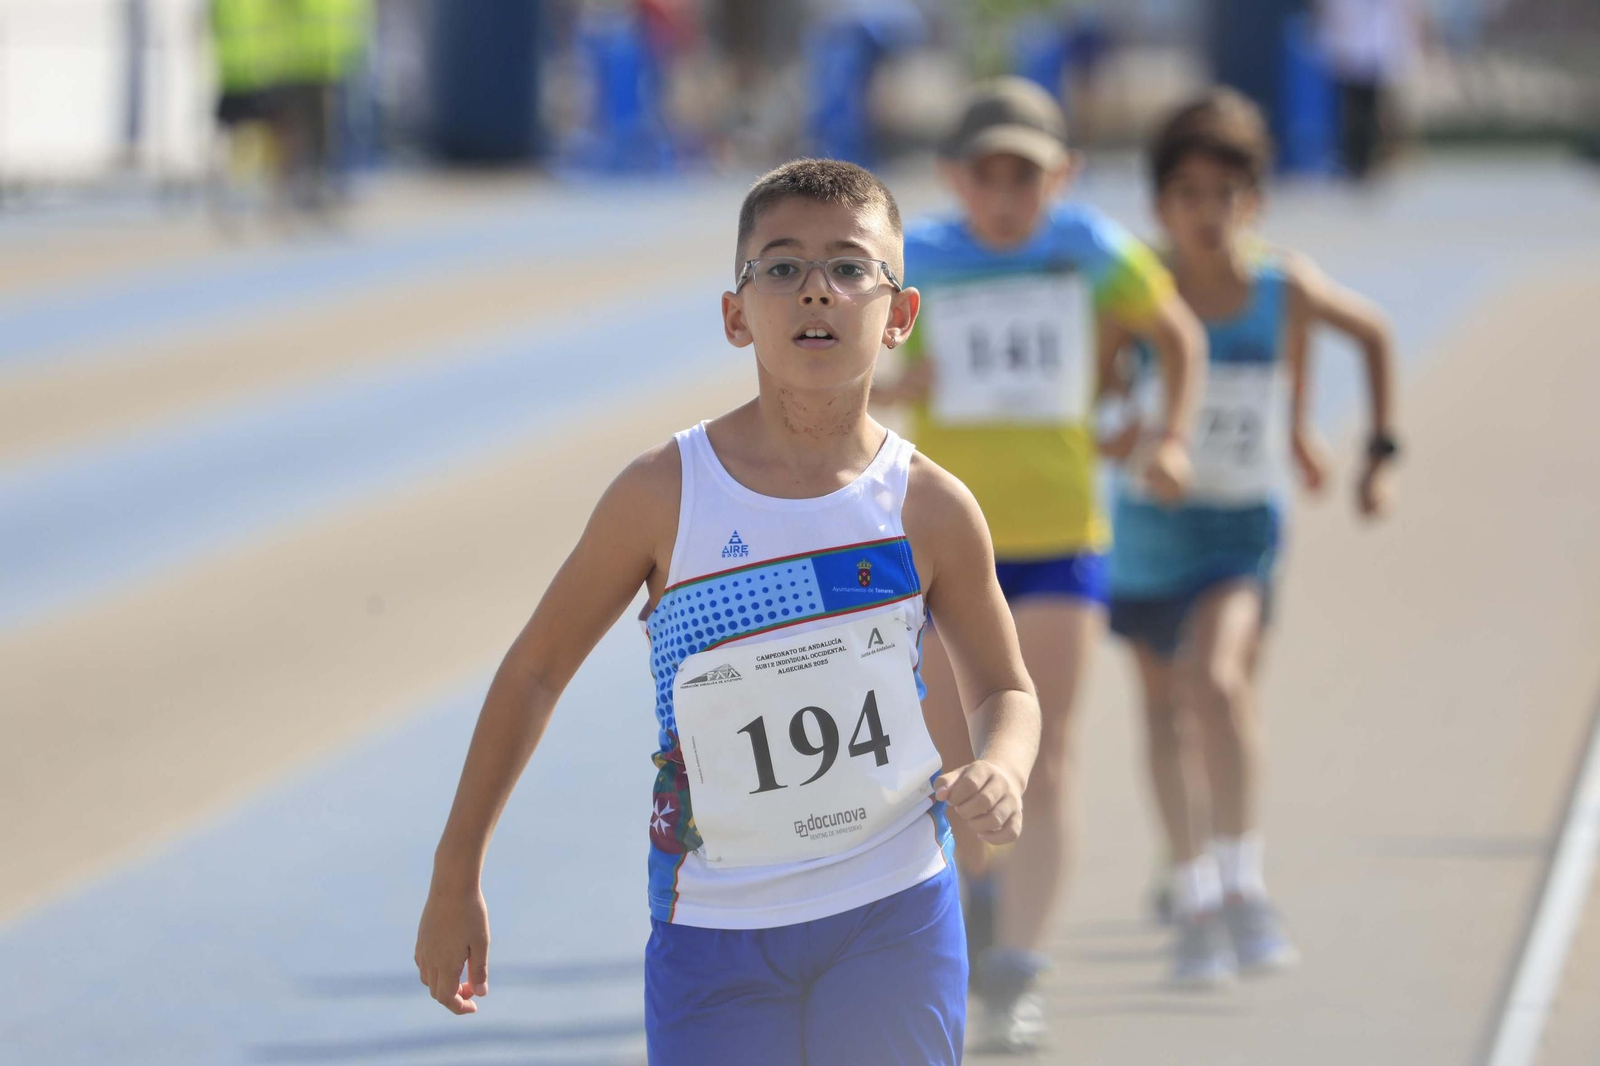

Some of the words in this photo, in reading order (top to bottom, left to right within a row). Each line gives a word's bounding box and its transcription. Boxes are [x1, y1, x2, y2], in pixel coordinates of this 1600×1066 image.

[722, 545, 749, 553] AIRE
[755, 662, 775, 671] SUB12
[776, 655, 810, 667] INDIVIDUAL
[810, 645, 847, 659] OCCIDENTAL
[756, 648, 798, 662] CAMPEONATO
[808, 637, 842, 651] ANDALUCÍA
[778, 662, 812, 675] ALGECIRAS
[813, 658, 829, 667] 2025
[736, 689, 891, 794] 194
[807, 807, 867, 831] docunova
[810, 831, 829, 840] RENTING
[835, 824, 863, 836] IMPRESORAS
